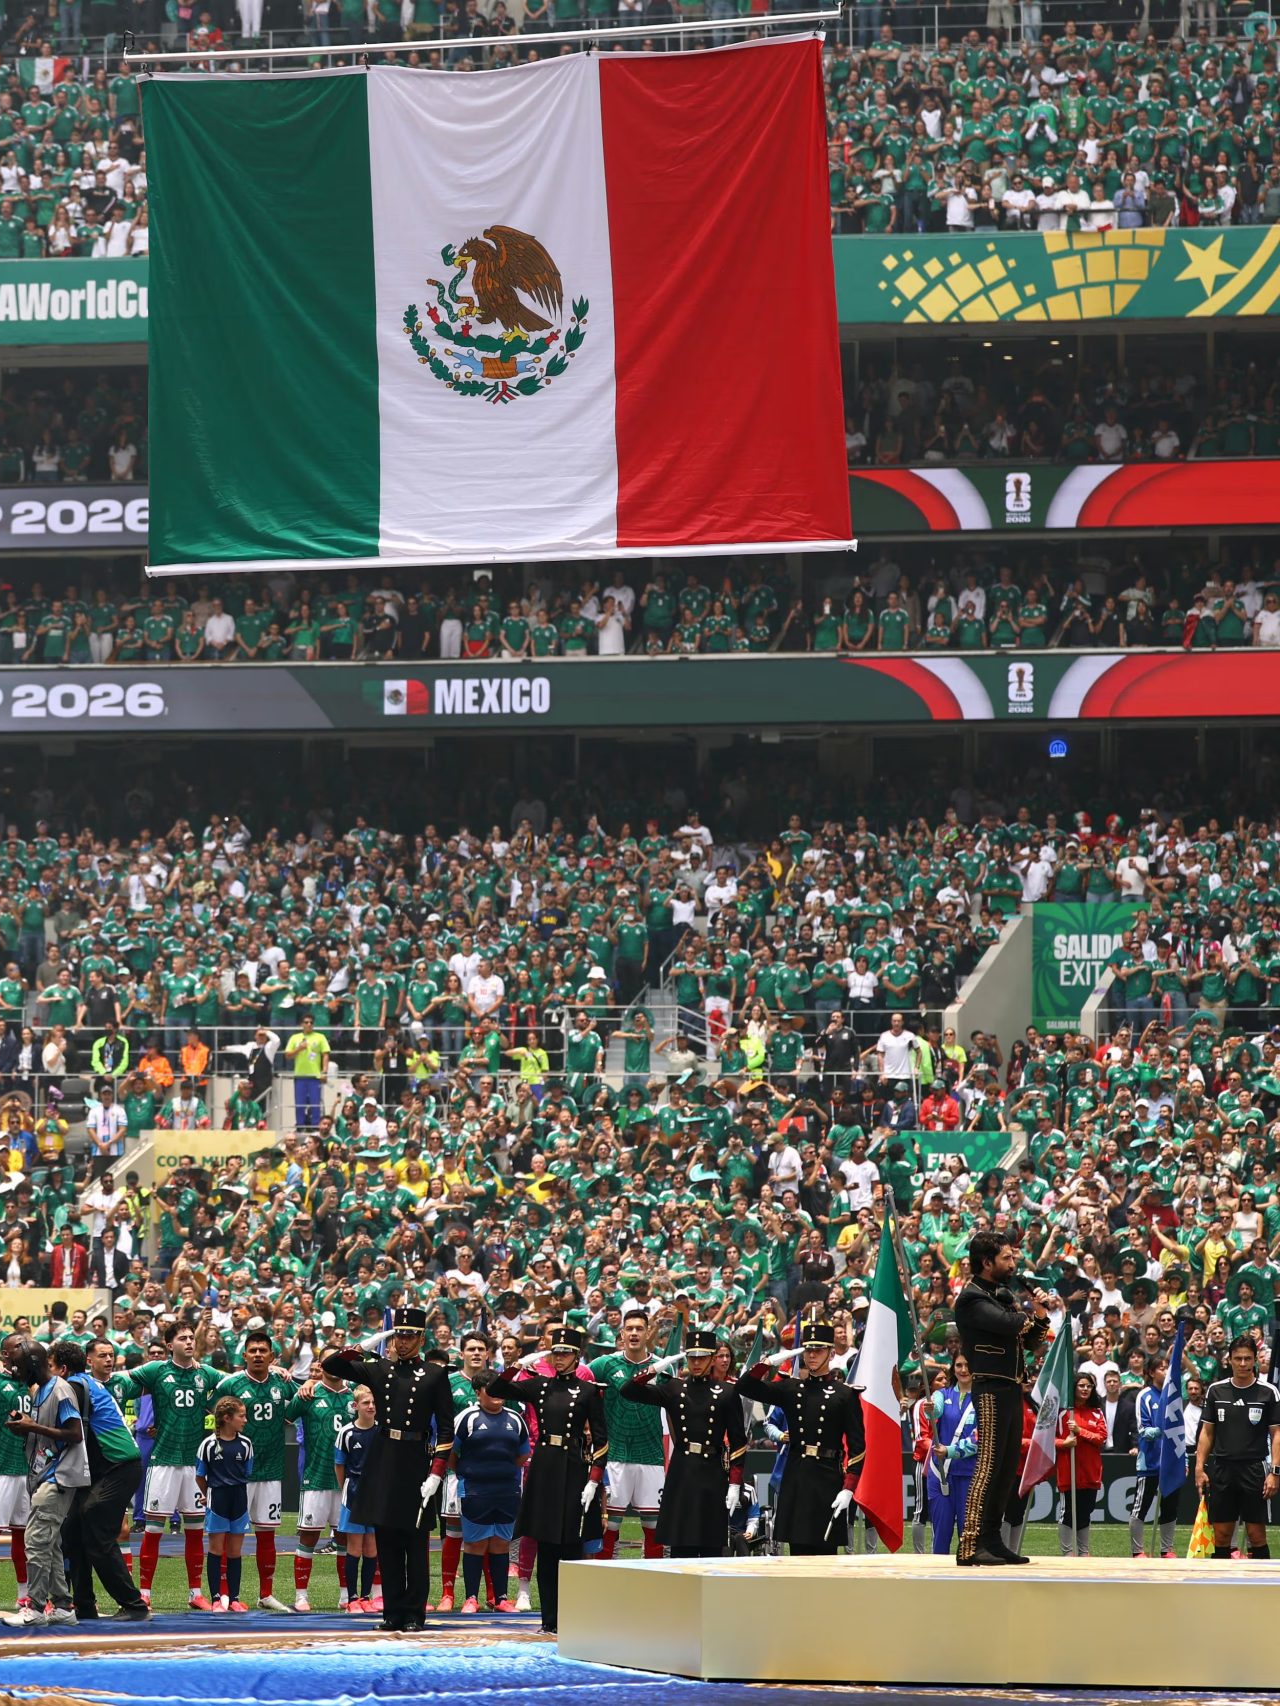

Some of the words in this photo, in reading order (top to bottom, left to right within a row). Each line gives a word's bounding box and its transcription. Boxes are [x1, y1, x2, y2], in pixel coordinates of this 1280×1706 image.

[10, 499, 149, 535] 2026
[10, 683, 164, 718] 2026
[434, 676, 551, 715] MEXICO
[1053, 933, 1124, 960] SALIDA
[1060, 960, 1104, 987] EXIT
[1046, 1020, 1068, 1030] SALIDA
[174, 1389, 195, 1408] 26
[253, 1402, 273, 1421] 23
[333, 1413, 343, 1432] 6
